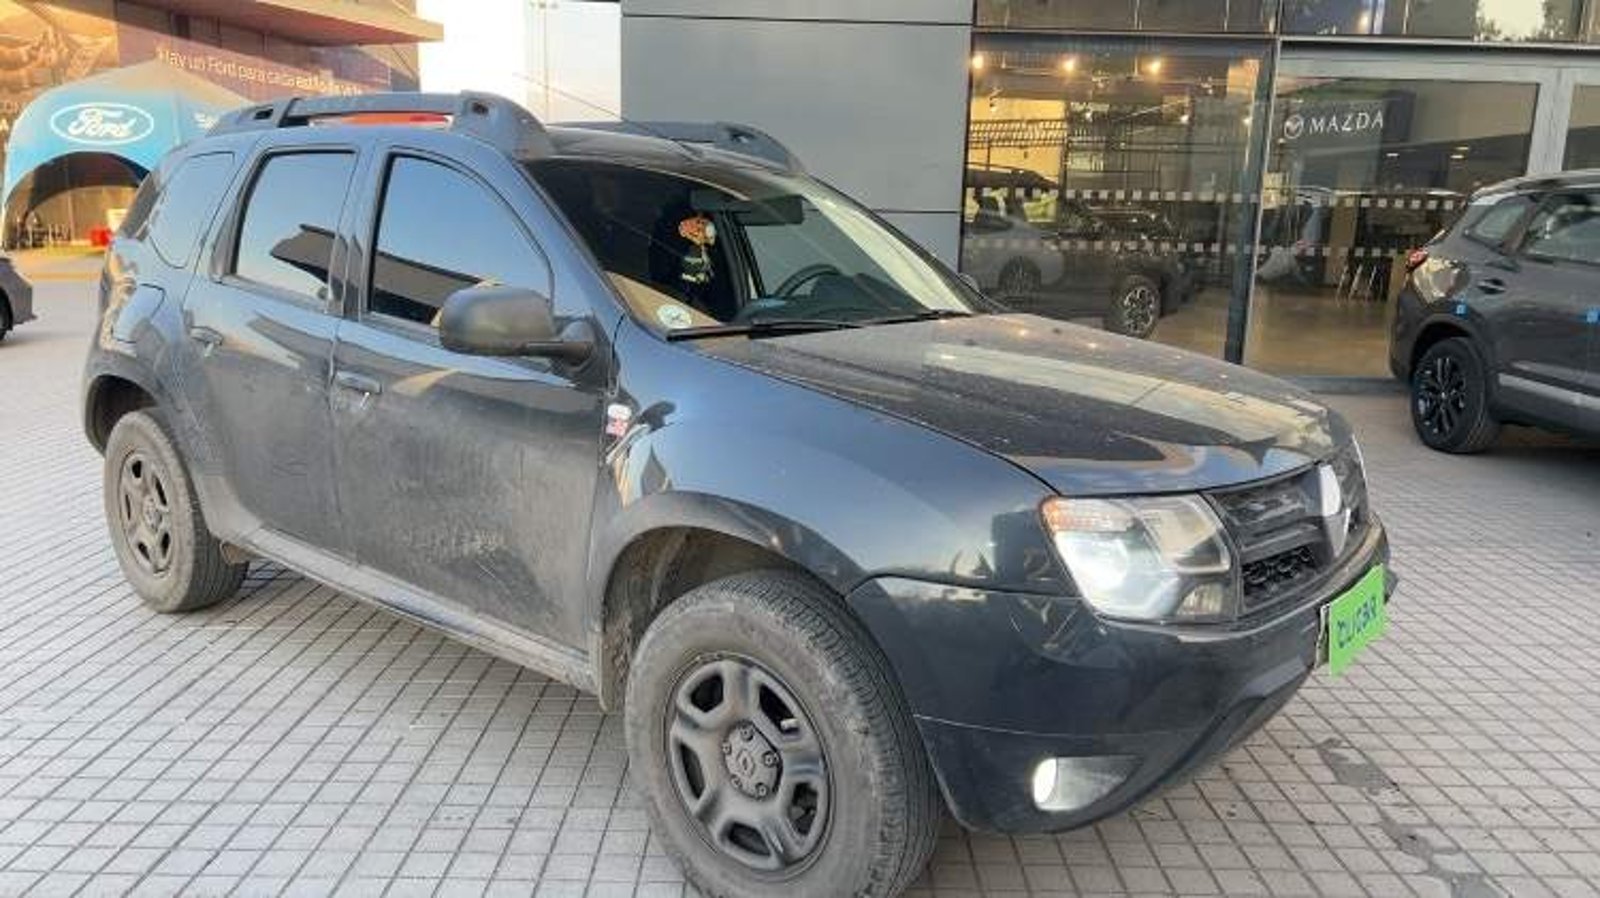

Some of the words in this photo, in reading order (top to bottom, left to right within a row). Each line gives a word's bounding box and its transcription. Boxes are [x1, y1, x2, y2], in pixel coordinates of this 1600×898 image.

[157, 47, 185, 68] Hay
[187, 56, 206, 71] un
[208, 57, 236, 77] Ford
[238, 66, 265, 83] para
[267, 70, 295, 86] cada
[67, 108, 137, 137] Ford
[1309, 109, 1384, 134] MAZDA
